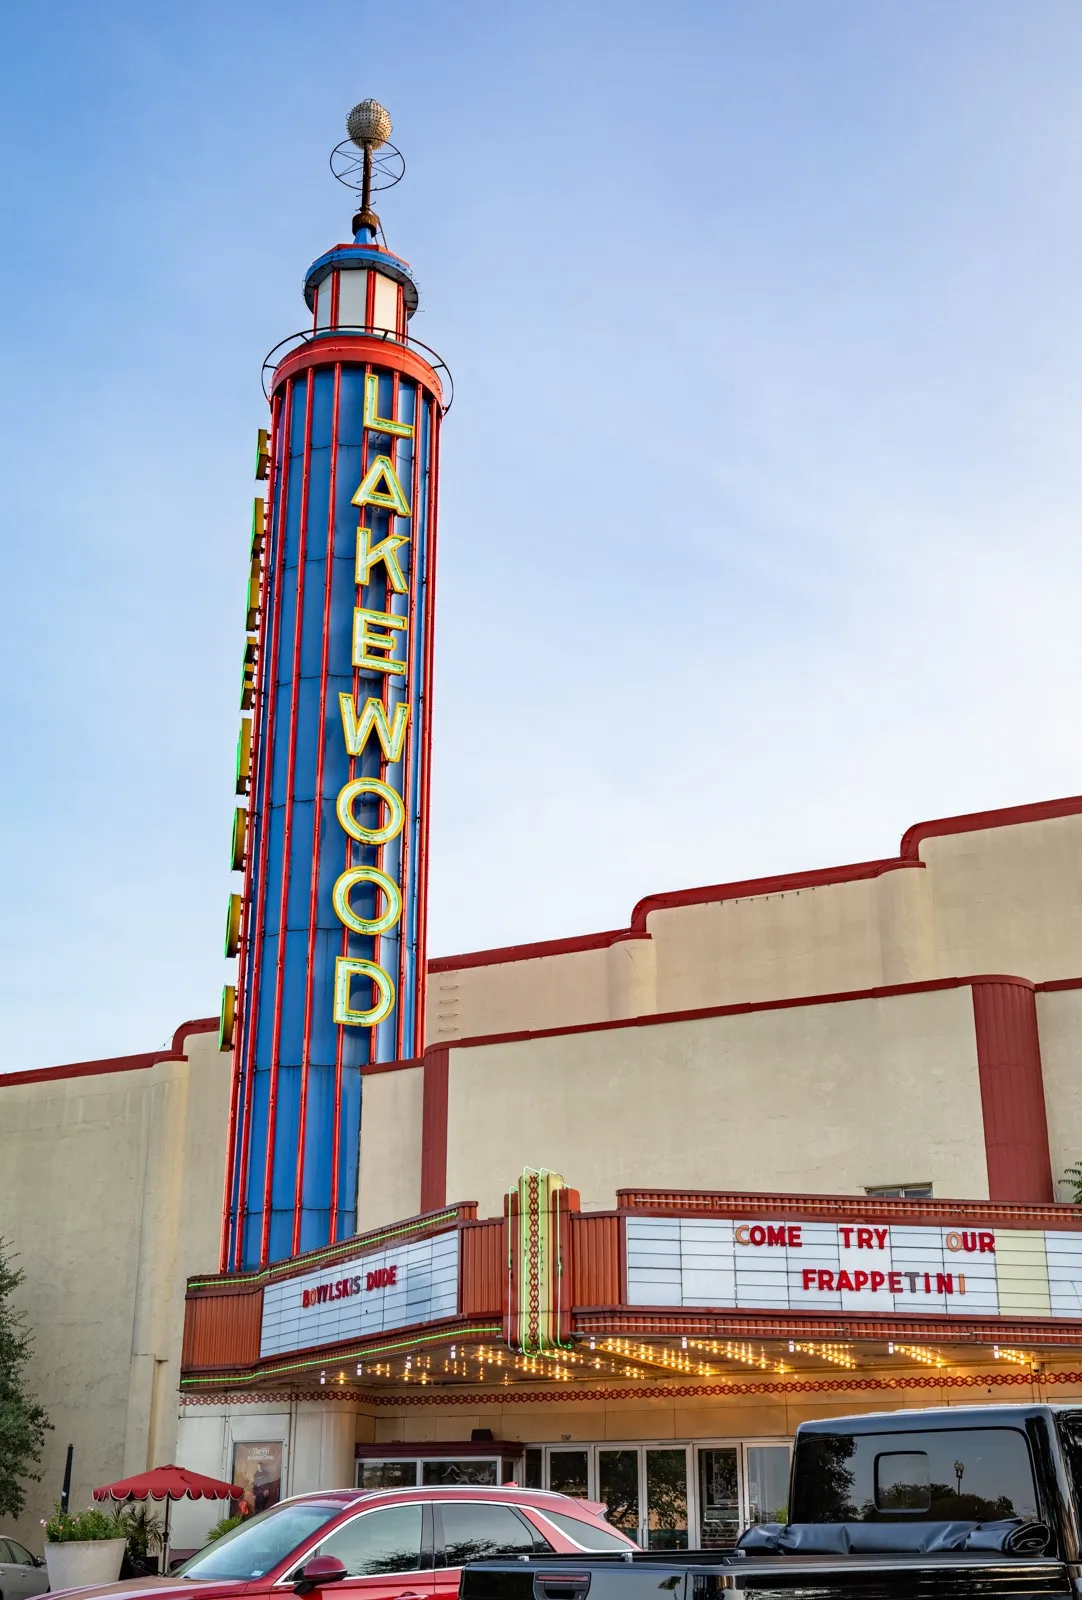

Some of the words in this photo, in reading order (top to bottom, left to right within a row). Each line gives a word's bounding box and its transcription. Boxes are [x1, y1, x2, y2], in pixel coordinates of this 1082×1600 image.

[333, 373, 415, 1027] LAKEWOOD
[734, 1224, 802, 1248] COME
[839, 1227, 888, 1250] TRY
[946, 1231, 995, 1253] OUR
[366, 1265, 397, 1291] DUDE
[802, 1269, 966, 1295] FRAPPETINI
